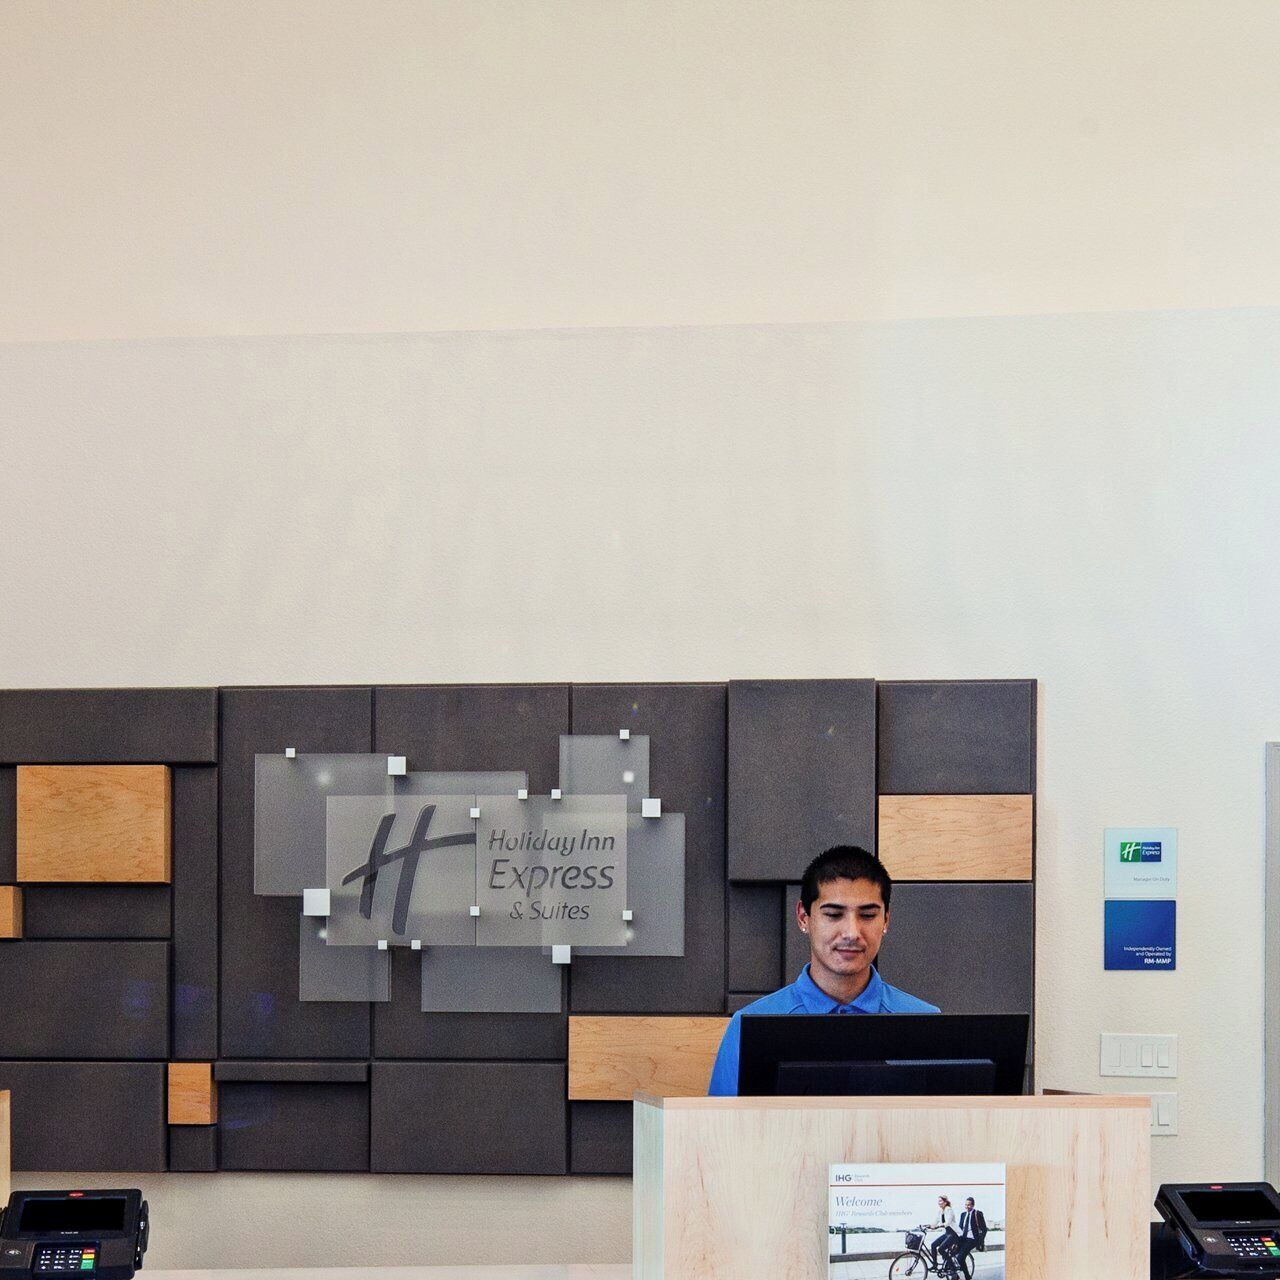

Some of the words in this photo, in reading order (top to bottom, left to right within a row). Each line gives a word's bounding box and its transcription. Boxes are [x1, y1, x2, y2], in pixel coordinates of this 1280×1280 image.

[488, 829, 576, 856] Holiday
[580, 829, 615, 850] Inn
[489, 859, 615, 897] Express
[510, 901, 523, 920] &
[529, 901, 590, 920] Suites
[835, 1174, 852, 1182] IHG
[836, 1196, 883, 1207] Welcome
